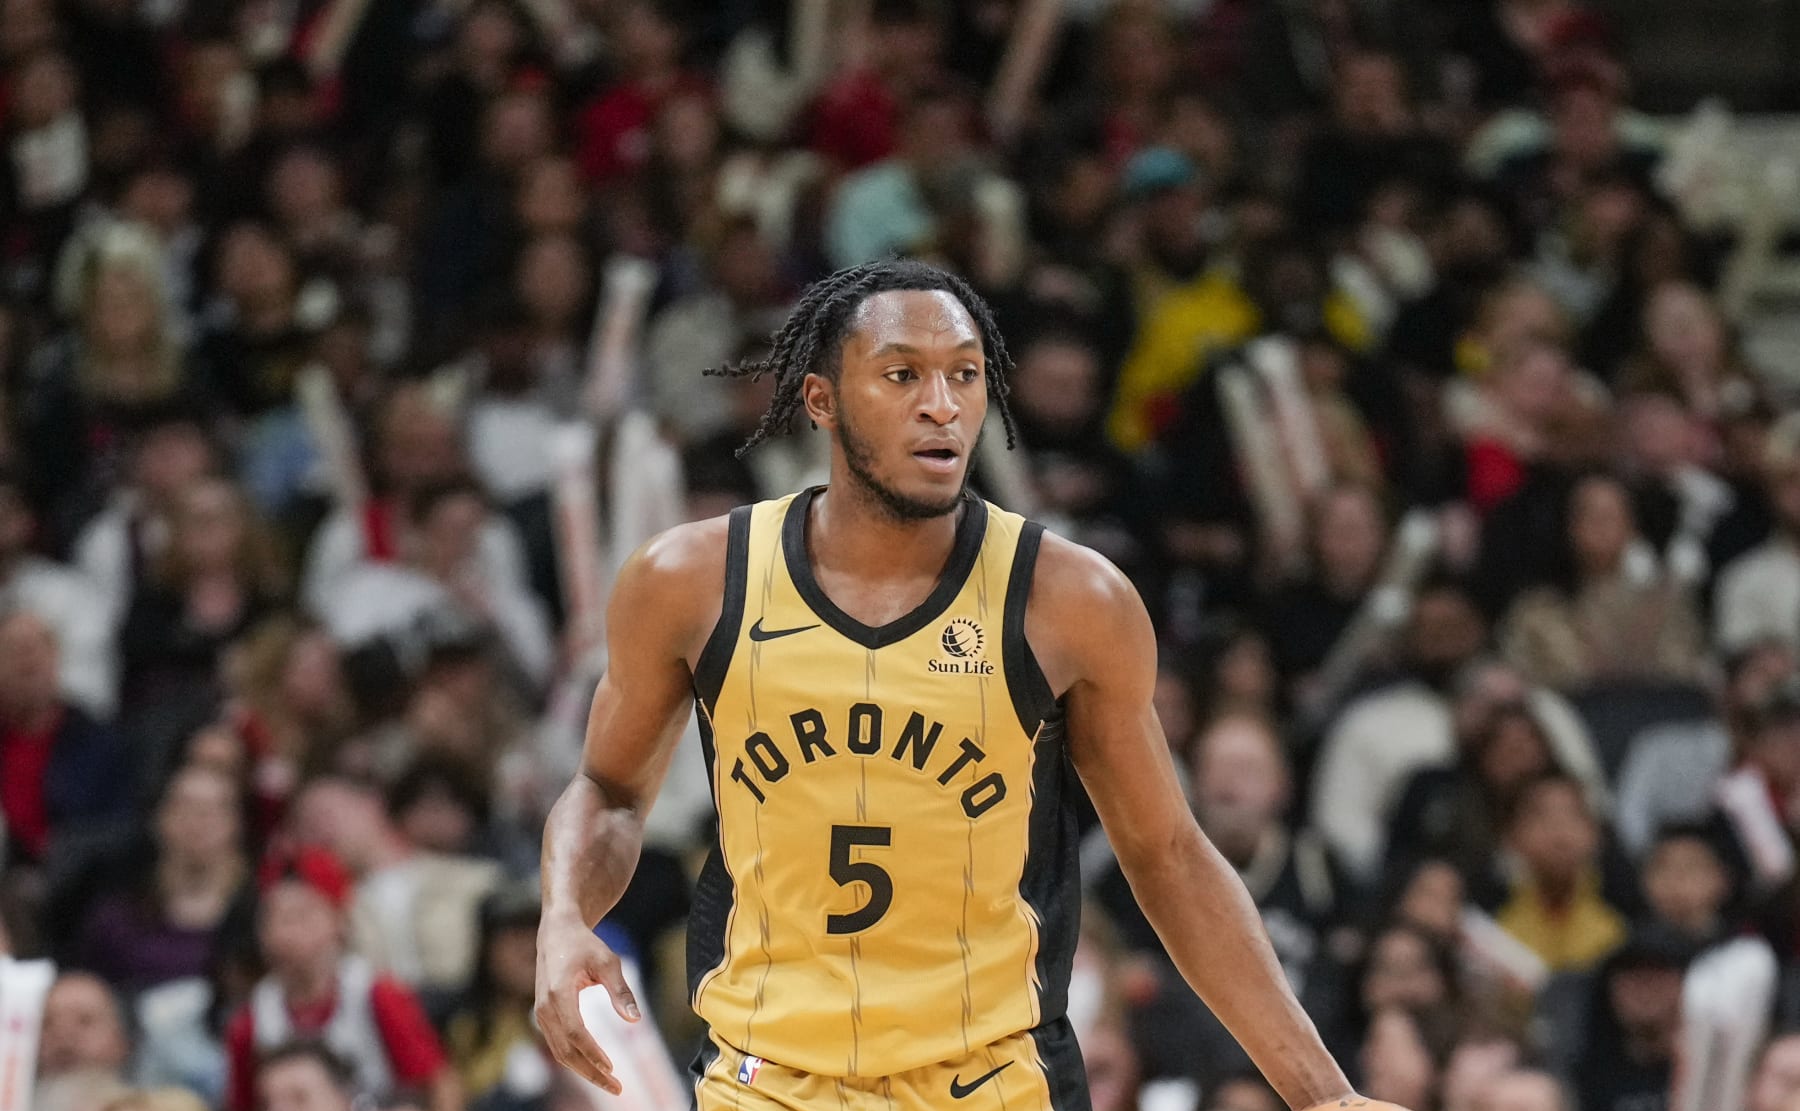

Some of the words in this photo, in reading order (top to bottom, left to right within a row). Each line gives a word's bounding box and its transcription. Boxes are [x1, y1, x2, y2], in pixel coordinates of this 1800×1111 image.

[928, 659, 960, 673] Sun
[964, 660, 995, 675] Life
[730, 702, 1007, 819] TORONTO
[826, 824, 894, 935] 5
